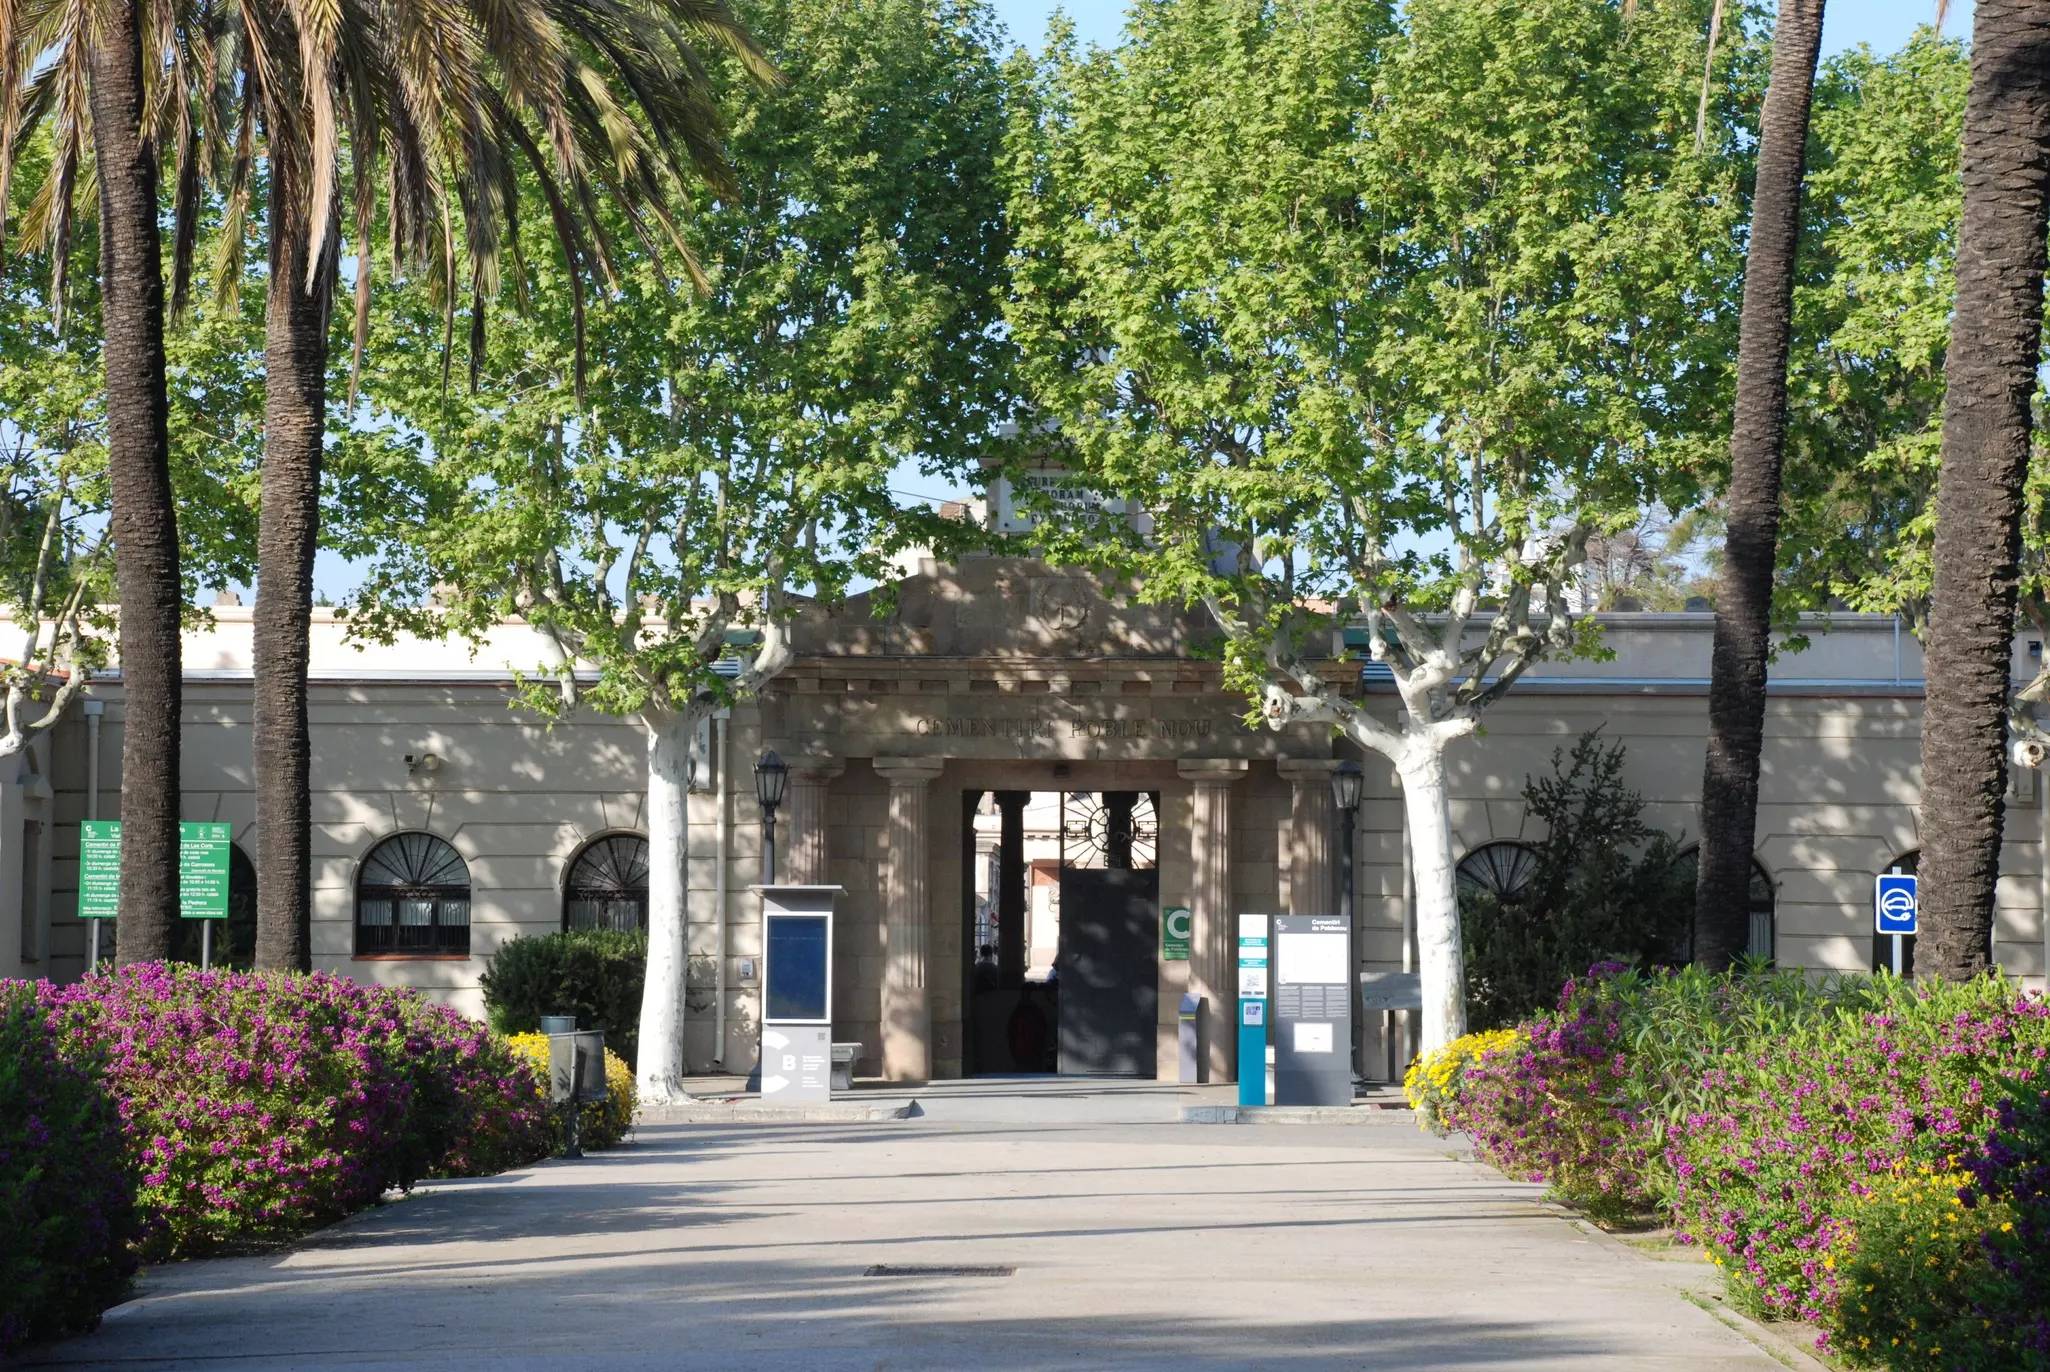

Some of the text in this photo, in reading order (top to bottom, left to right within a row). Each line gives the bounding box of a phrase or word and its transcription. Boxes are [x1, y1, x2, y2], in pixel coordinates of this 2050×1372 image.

[917, 719, 1211, 738] CEMENTIRI POBLE NOU
[1166, 909, 1191, 939] C
[782, 1054, 796, 1071] B
